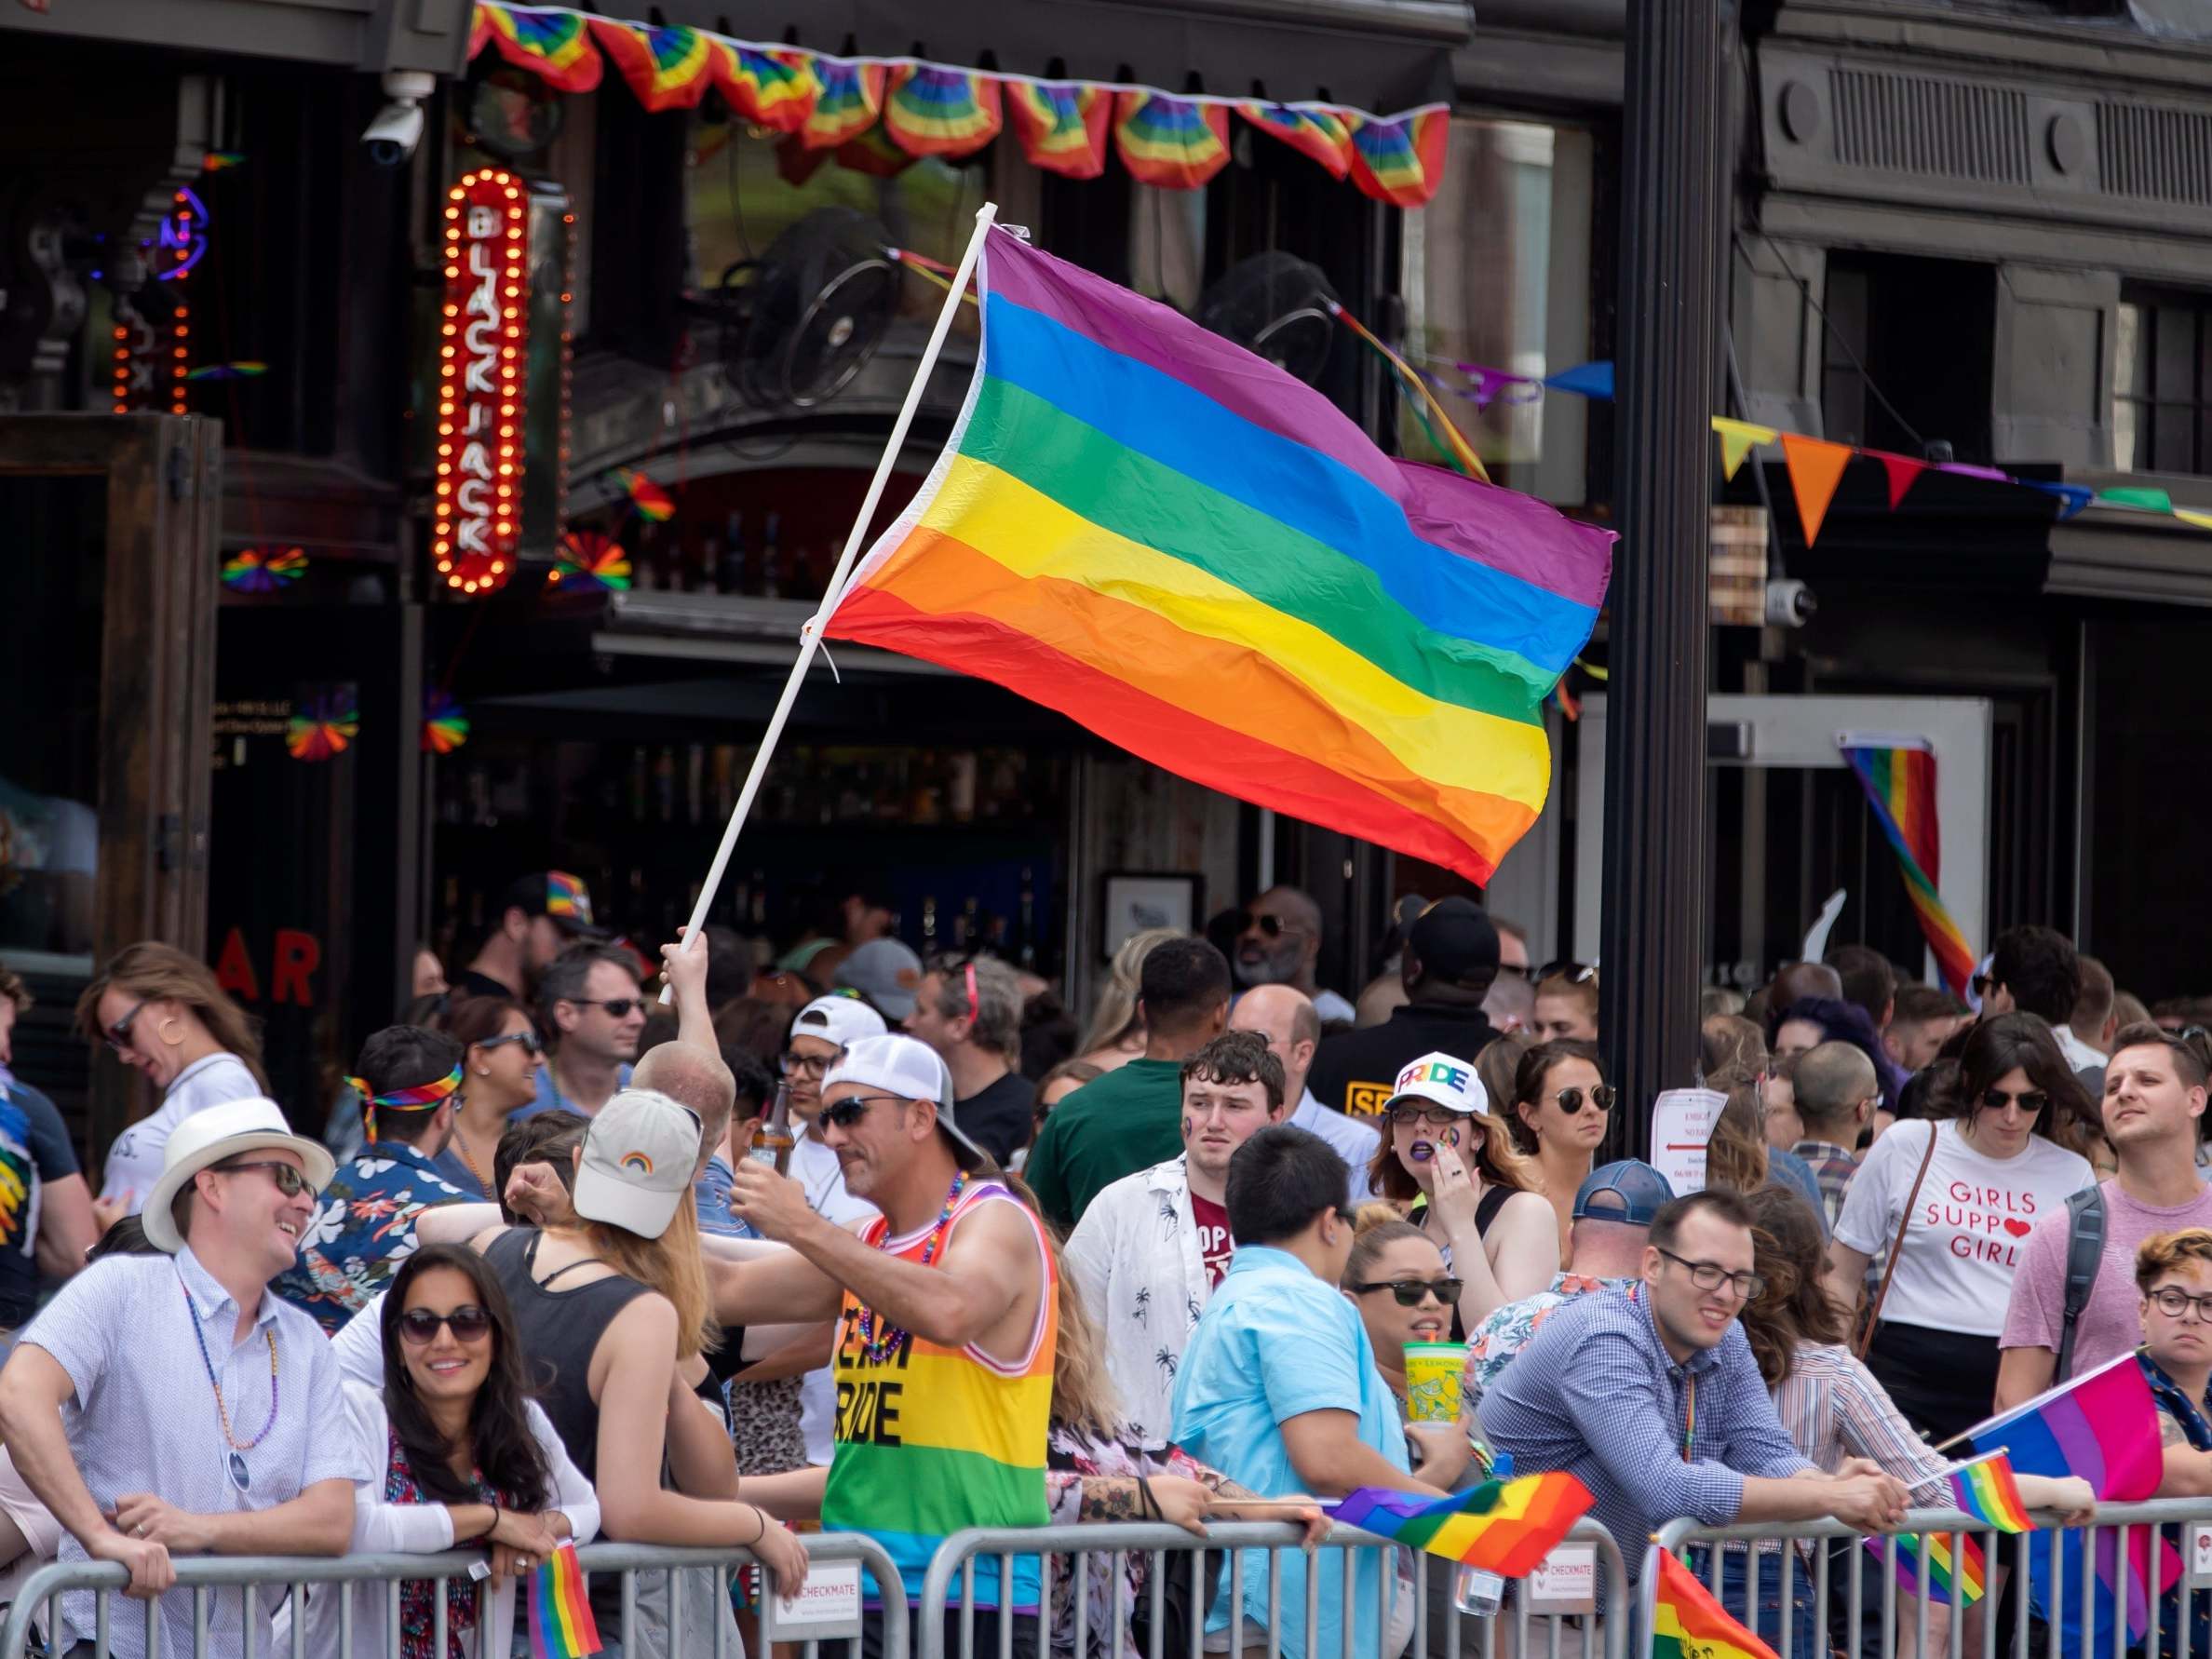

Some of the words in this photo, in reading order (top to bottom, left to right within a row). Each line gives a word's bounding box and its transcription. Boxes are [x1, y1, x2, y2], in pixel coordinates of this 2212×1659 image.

[465, 205, 504, 393] BLACK
[457, 401, 494, 556] JACK
[1397, 1062, 1470, 1094] PRIDE
[1949, 1180, 2036, 1214] GIRLS
[1950, 1235, 2016, 1267] GIRL
[1551, 1565, 1592, 1575] CHECKMATE
